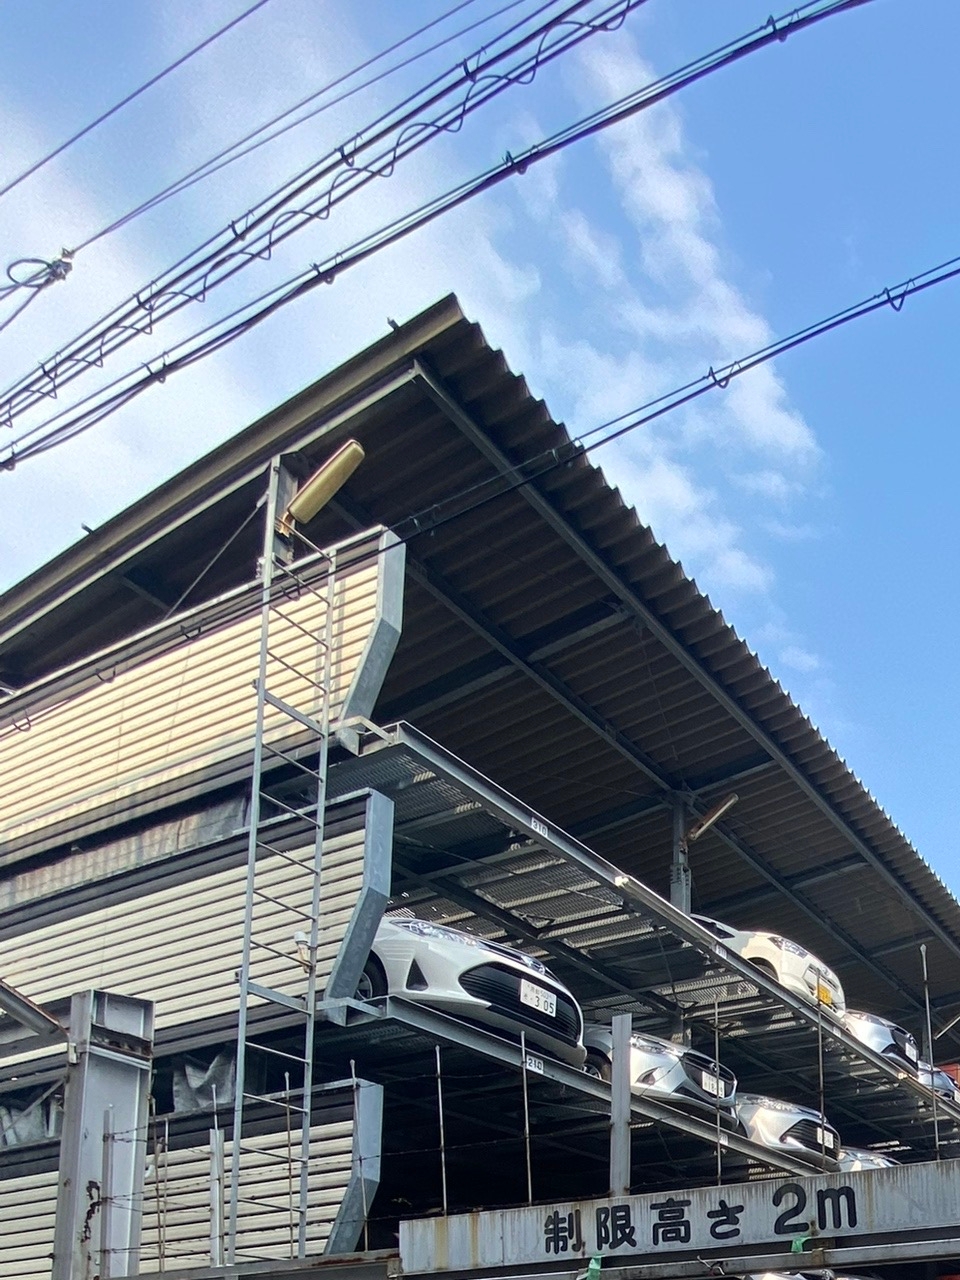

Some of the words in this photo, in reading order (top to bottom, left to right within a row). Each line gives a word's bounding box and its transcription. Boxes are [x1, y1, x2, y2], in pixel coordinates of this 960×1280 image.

[543, 1196, 745, 1255] 制限高さ
[771, 1183, 858, 1236] 2m
